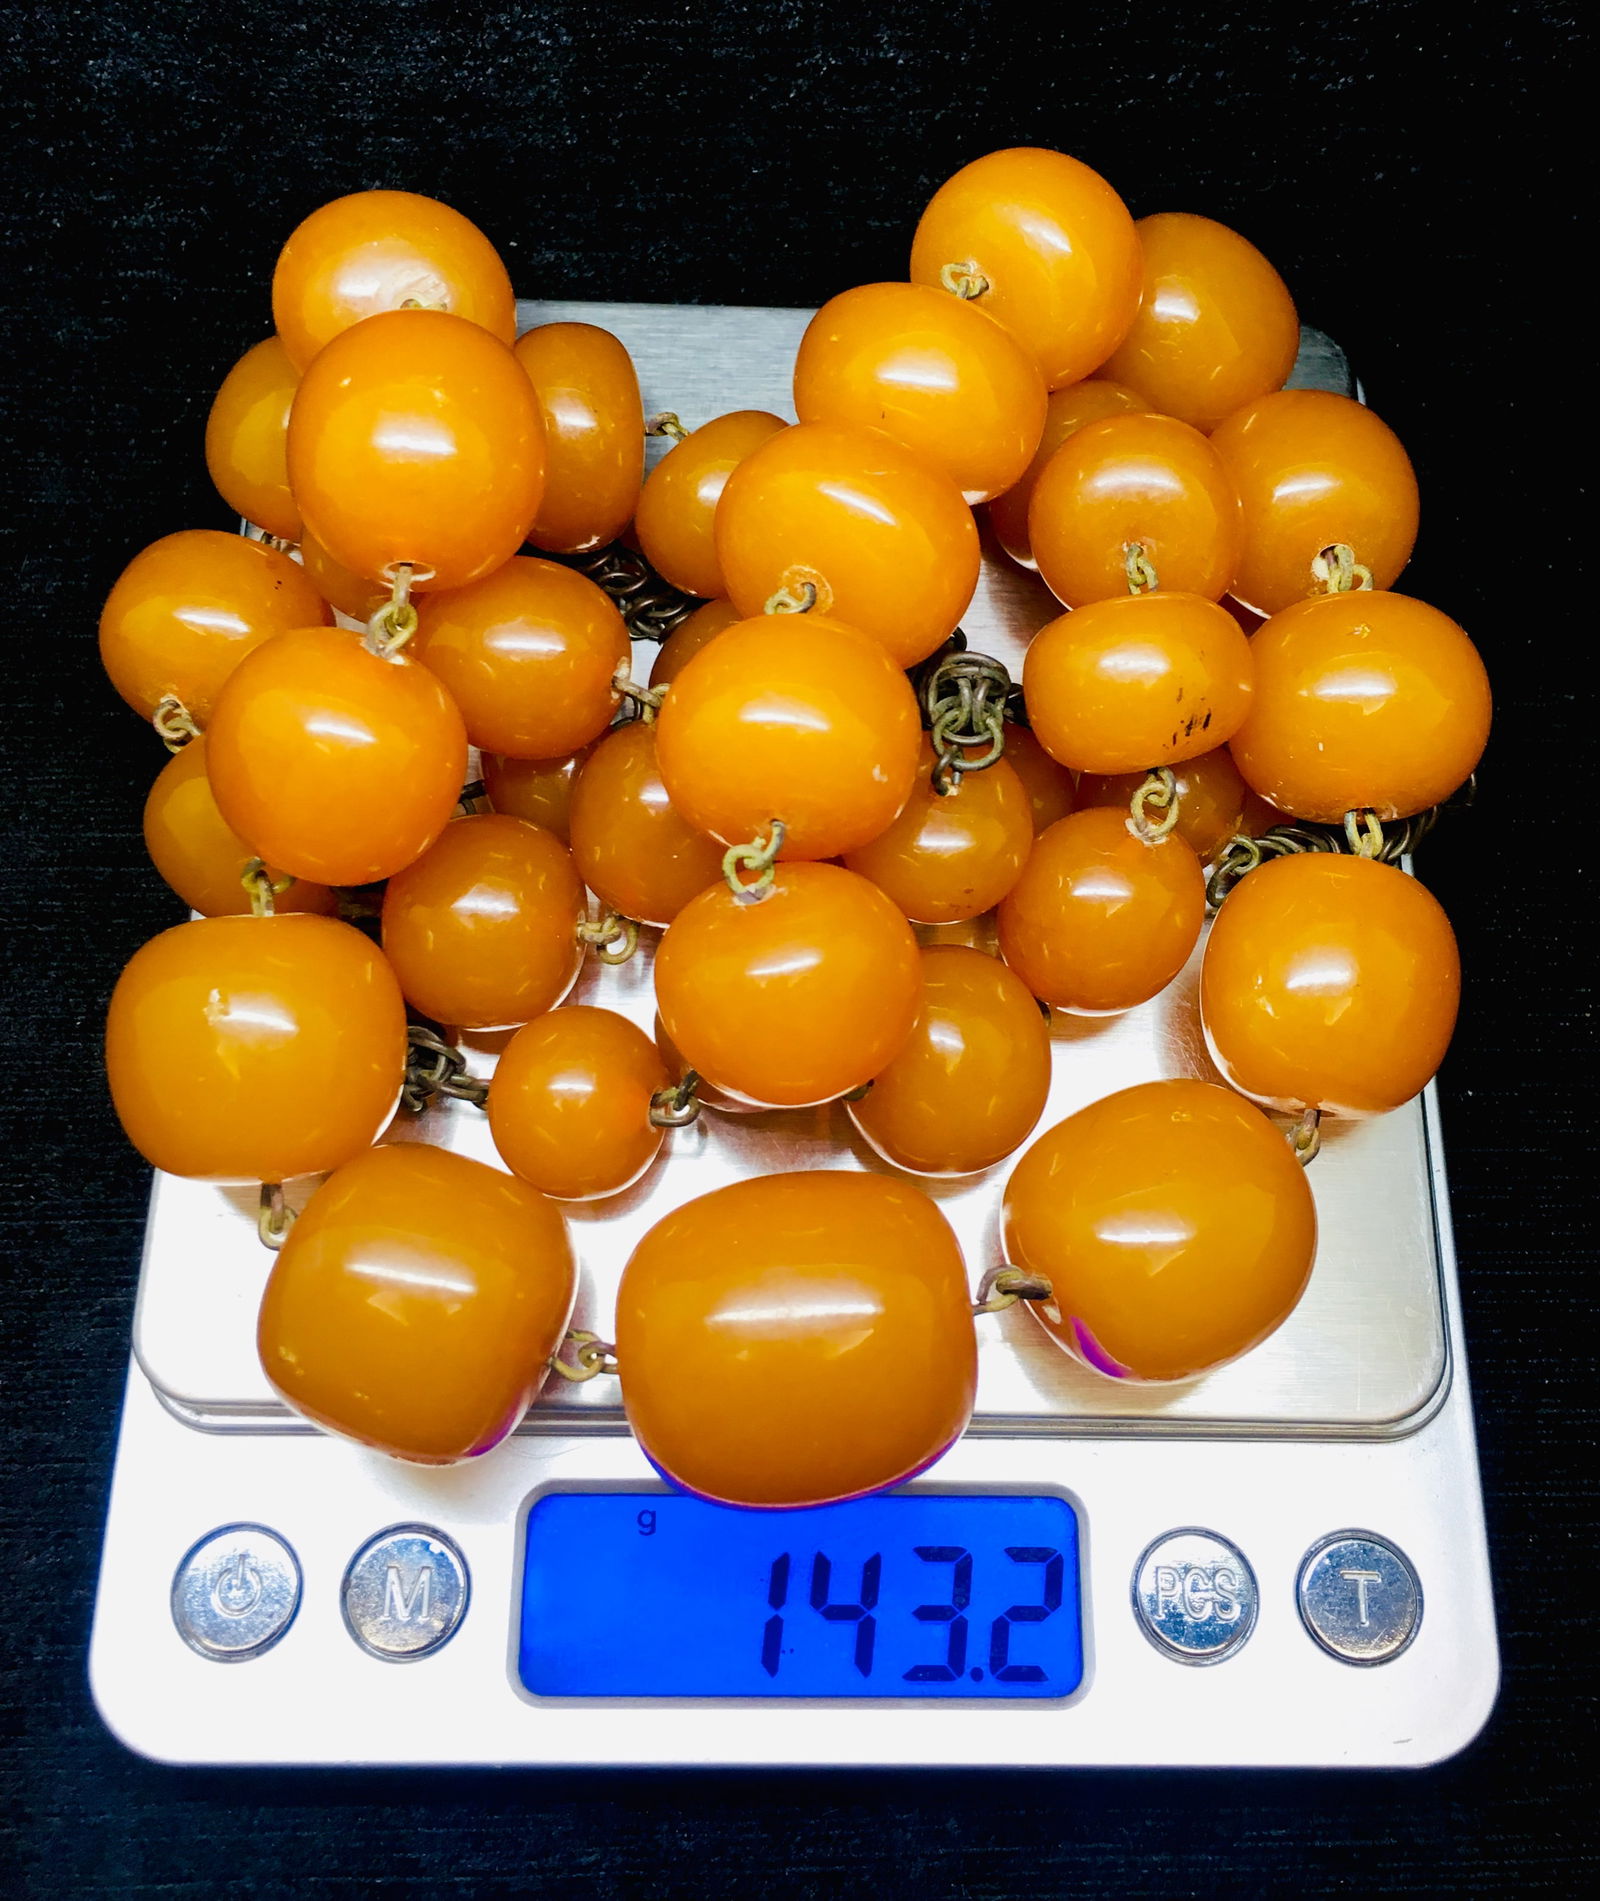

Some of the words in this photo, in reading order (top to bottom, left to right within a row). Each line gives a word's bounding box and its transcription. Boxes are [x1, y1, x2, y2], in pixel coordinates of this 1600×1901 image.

[637, 1509, 657, 1537] g
[382, 1564, 433, 1621] M
[760, 1545, 1064, 1682] 143.2
[1155, 1565, 1241, 1622] PCS
[1339, 1569, 1382, 1627] T
